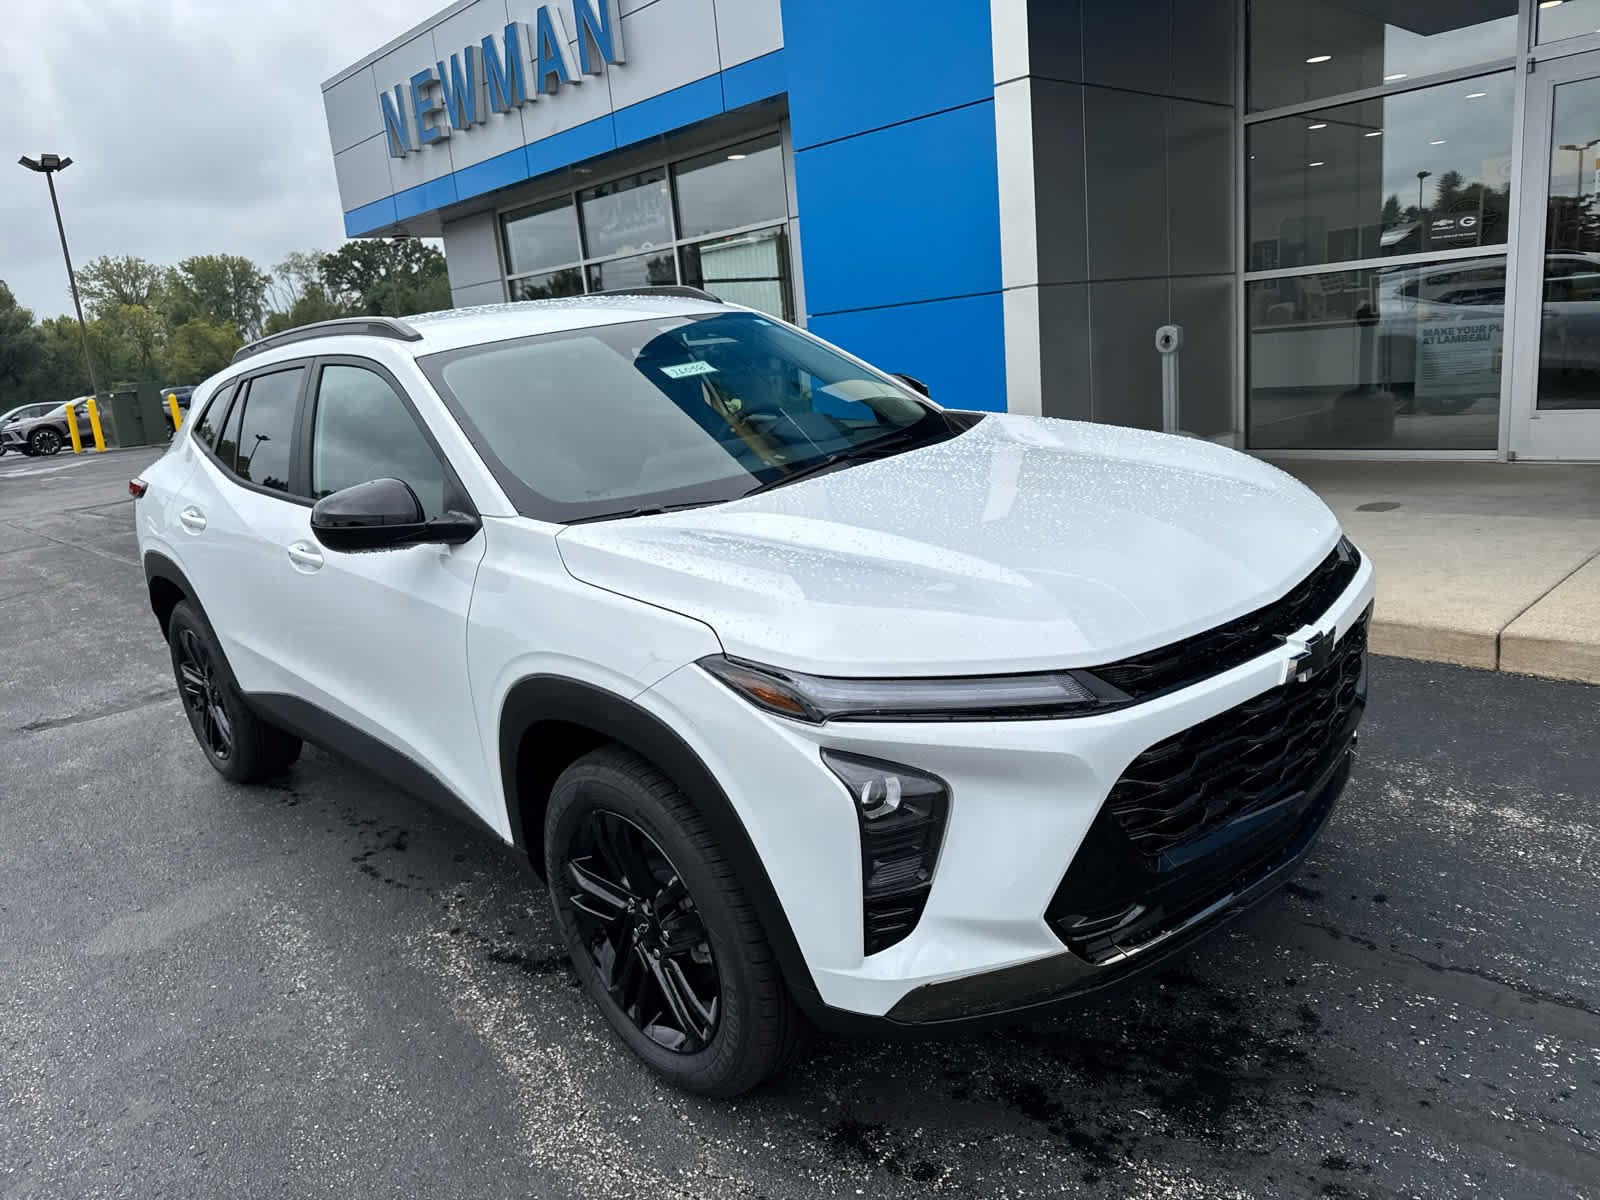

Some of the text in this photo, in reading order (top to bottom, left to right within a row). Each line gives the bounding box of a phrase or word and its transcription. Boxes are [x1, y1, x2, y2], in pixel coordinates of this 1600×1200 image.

[379, 0, 625, 158] NEWMAN
[1459, 216, 1477, 227] G
[1423, 323, 1504, 337] MAKE YOUR PL
[1423, 333, 1491, 345] AT LAMBEAU
